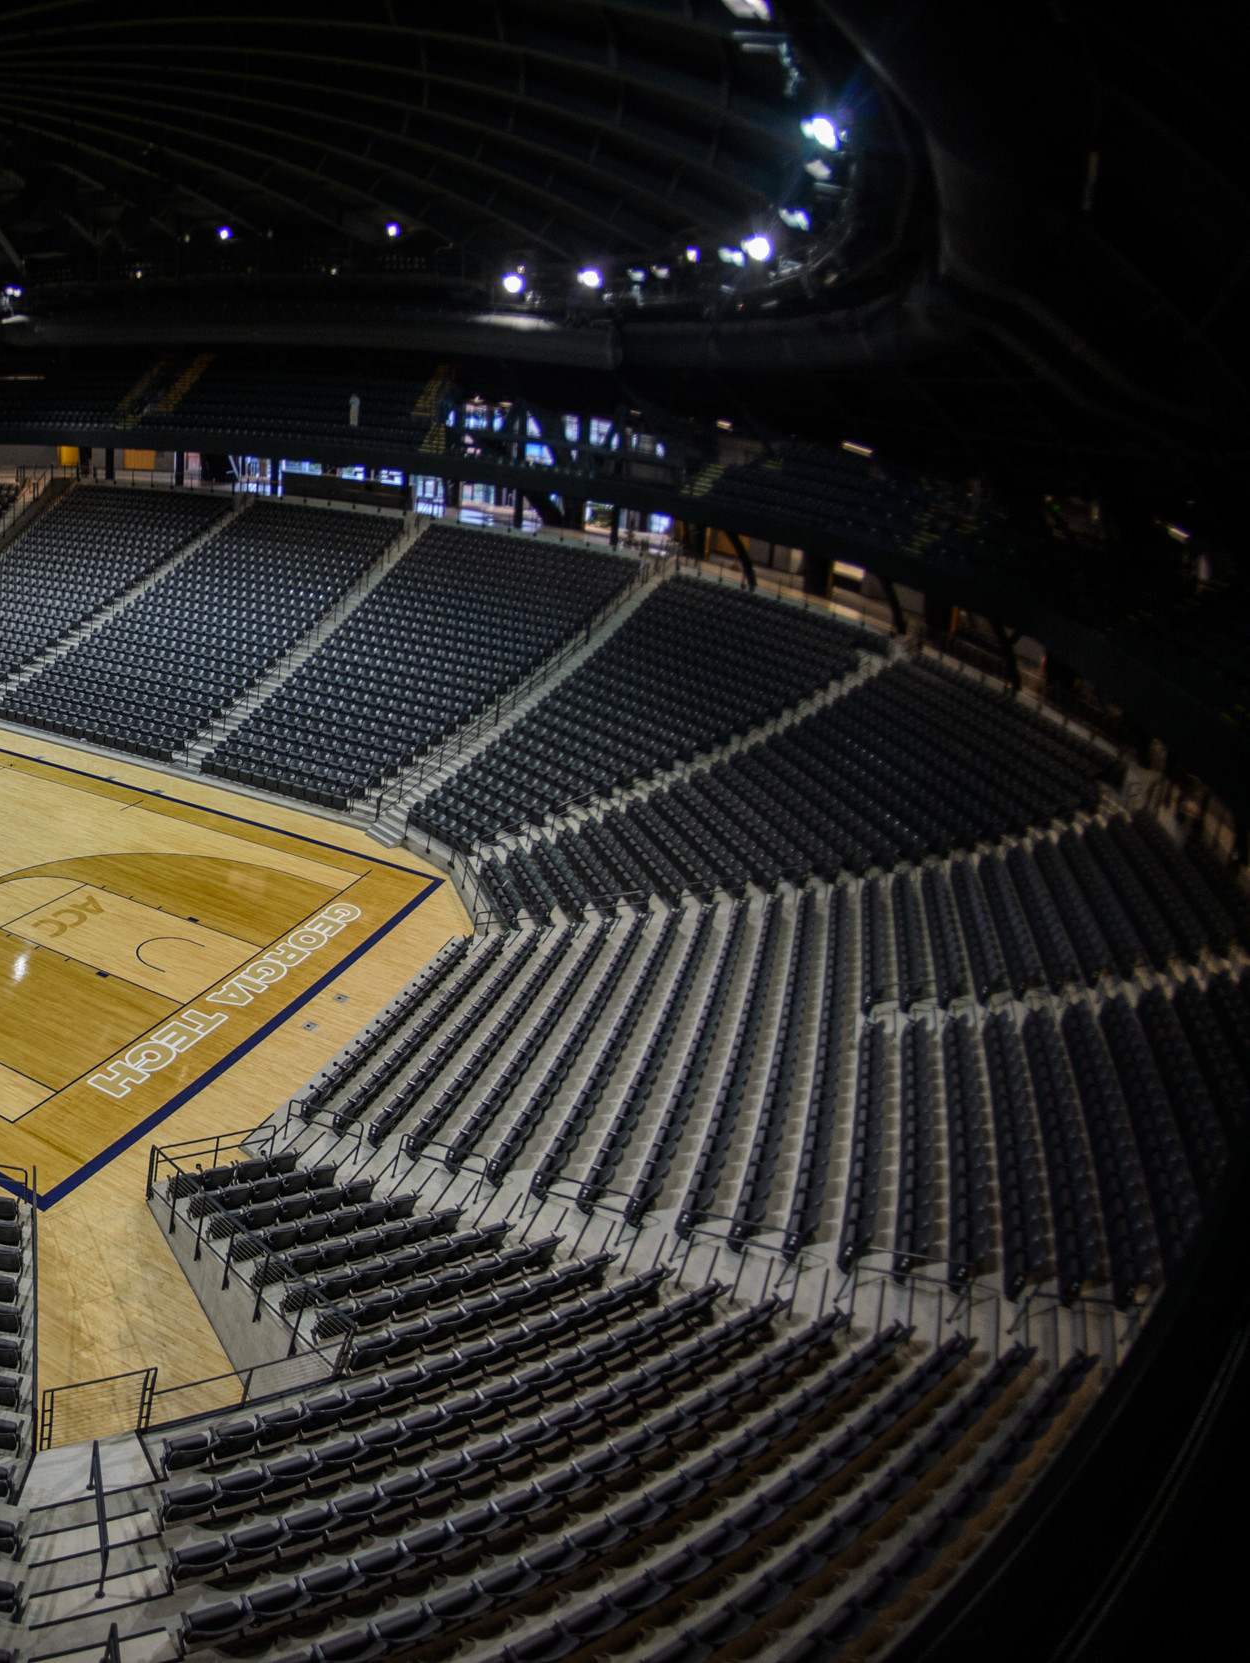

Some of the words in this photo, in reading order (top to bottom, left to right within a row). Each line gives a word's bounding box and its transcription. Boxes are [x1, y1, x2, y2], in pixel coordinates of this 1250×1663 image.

[31, 895, 105, 938] ACC
[206, 902, 362, 1006] GEORGIA
[87, 1008, 229, 1099] TECH
